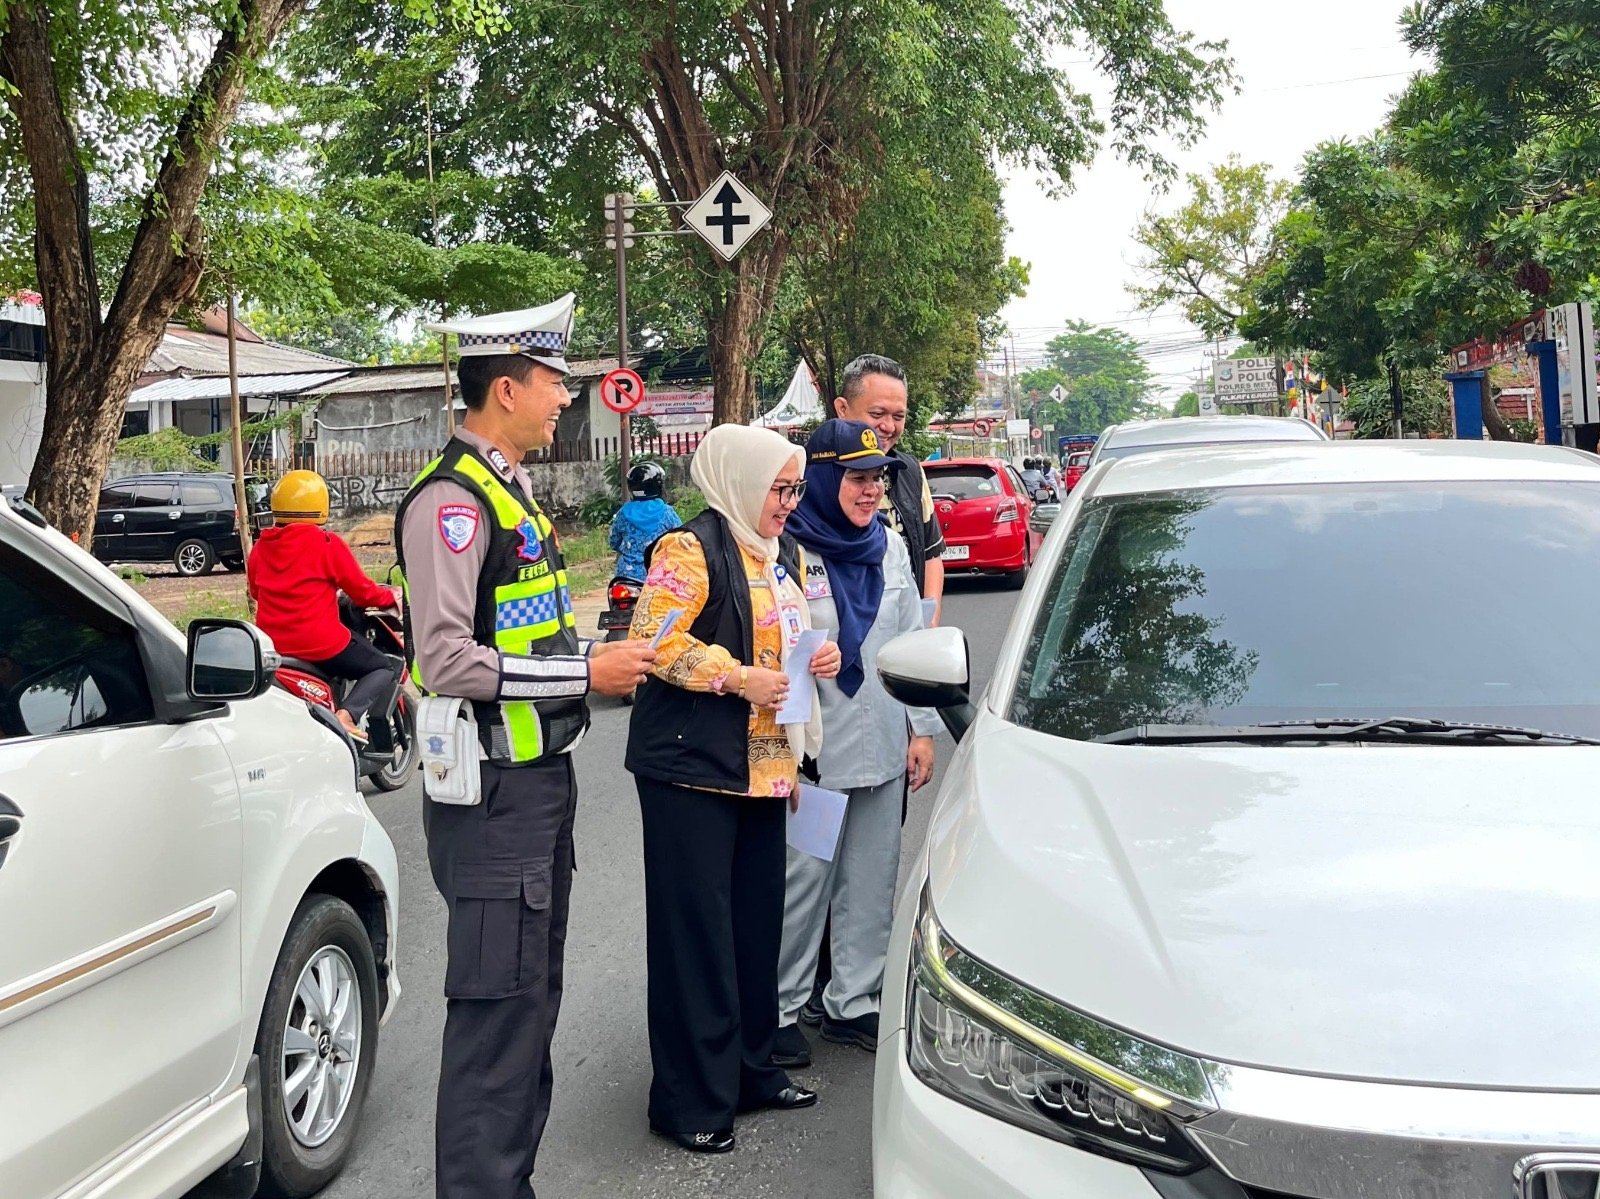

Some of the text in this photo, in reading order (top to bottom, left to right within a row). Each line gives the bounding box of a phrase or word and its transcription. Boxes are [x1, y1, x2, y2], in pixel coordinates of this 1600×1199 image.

[1237, 358, 1276, 368] POLIS
[1238, 372, 1276, 382] POLIC
[1254, 381, 1277, 389] METR
[615, 379, 633, 403] P
